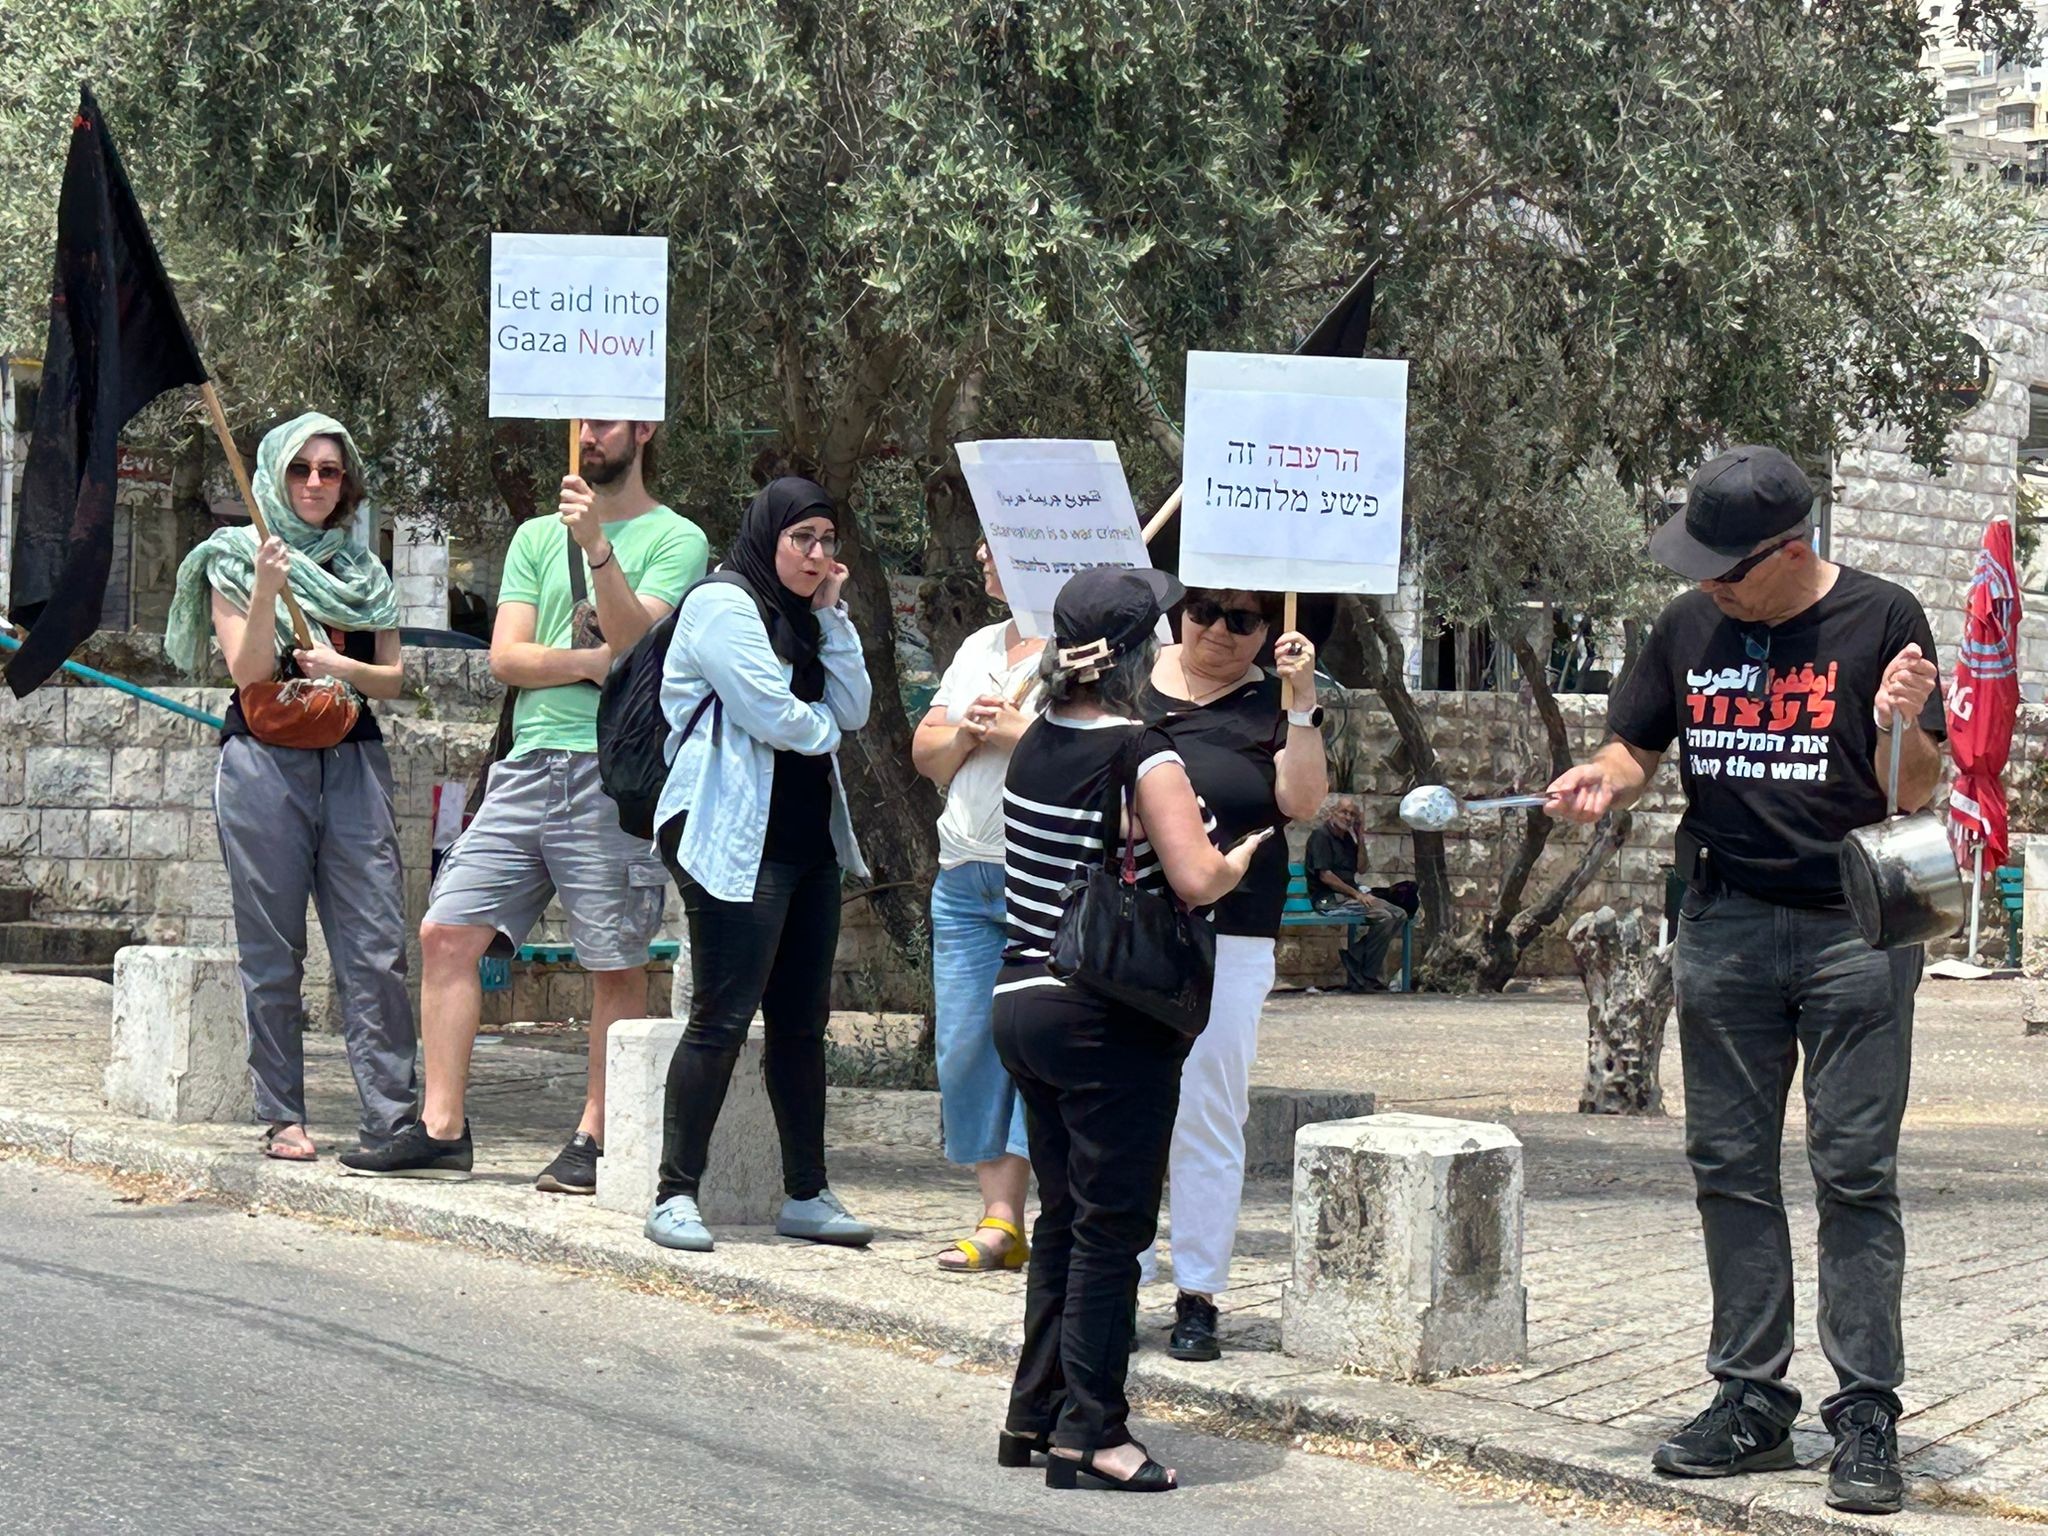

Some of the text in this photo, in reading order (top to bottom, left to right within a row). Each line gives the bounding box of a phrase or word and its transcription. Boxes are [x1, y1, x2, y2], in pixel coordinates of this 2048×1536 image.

[498, 283, 660, 315] Let aid into
[497, 324, 655, 358] Gaza Now!
[1228, 440, 1359, 472] הרעבה זה
[1205, 477, 1379, 518] פשע מלחמה!
[989, 522, 1045, 541] Starvation
[1686, 663, 1762, 697] الحرب
[1686, 693, 1836, 731] לעצור
[1791, 734, 1830, 754] את
[1725, 755, 1766, 779] the
[1770, 758, 1829, 782] war!
